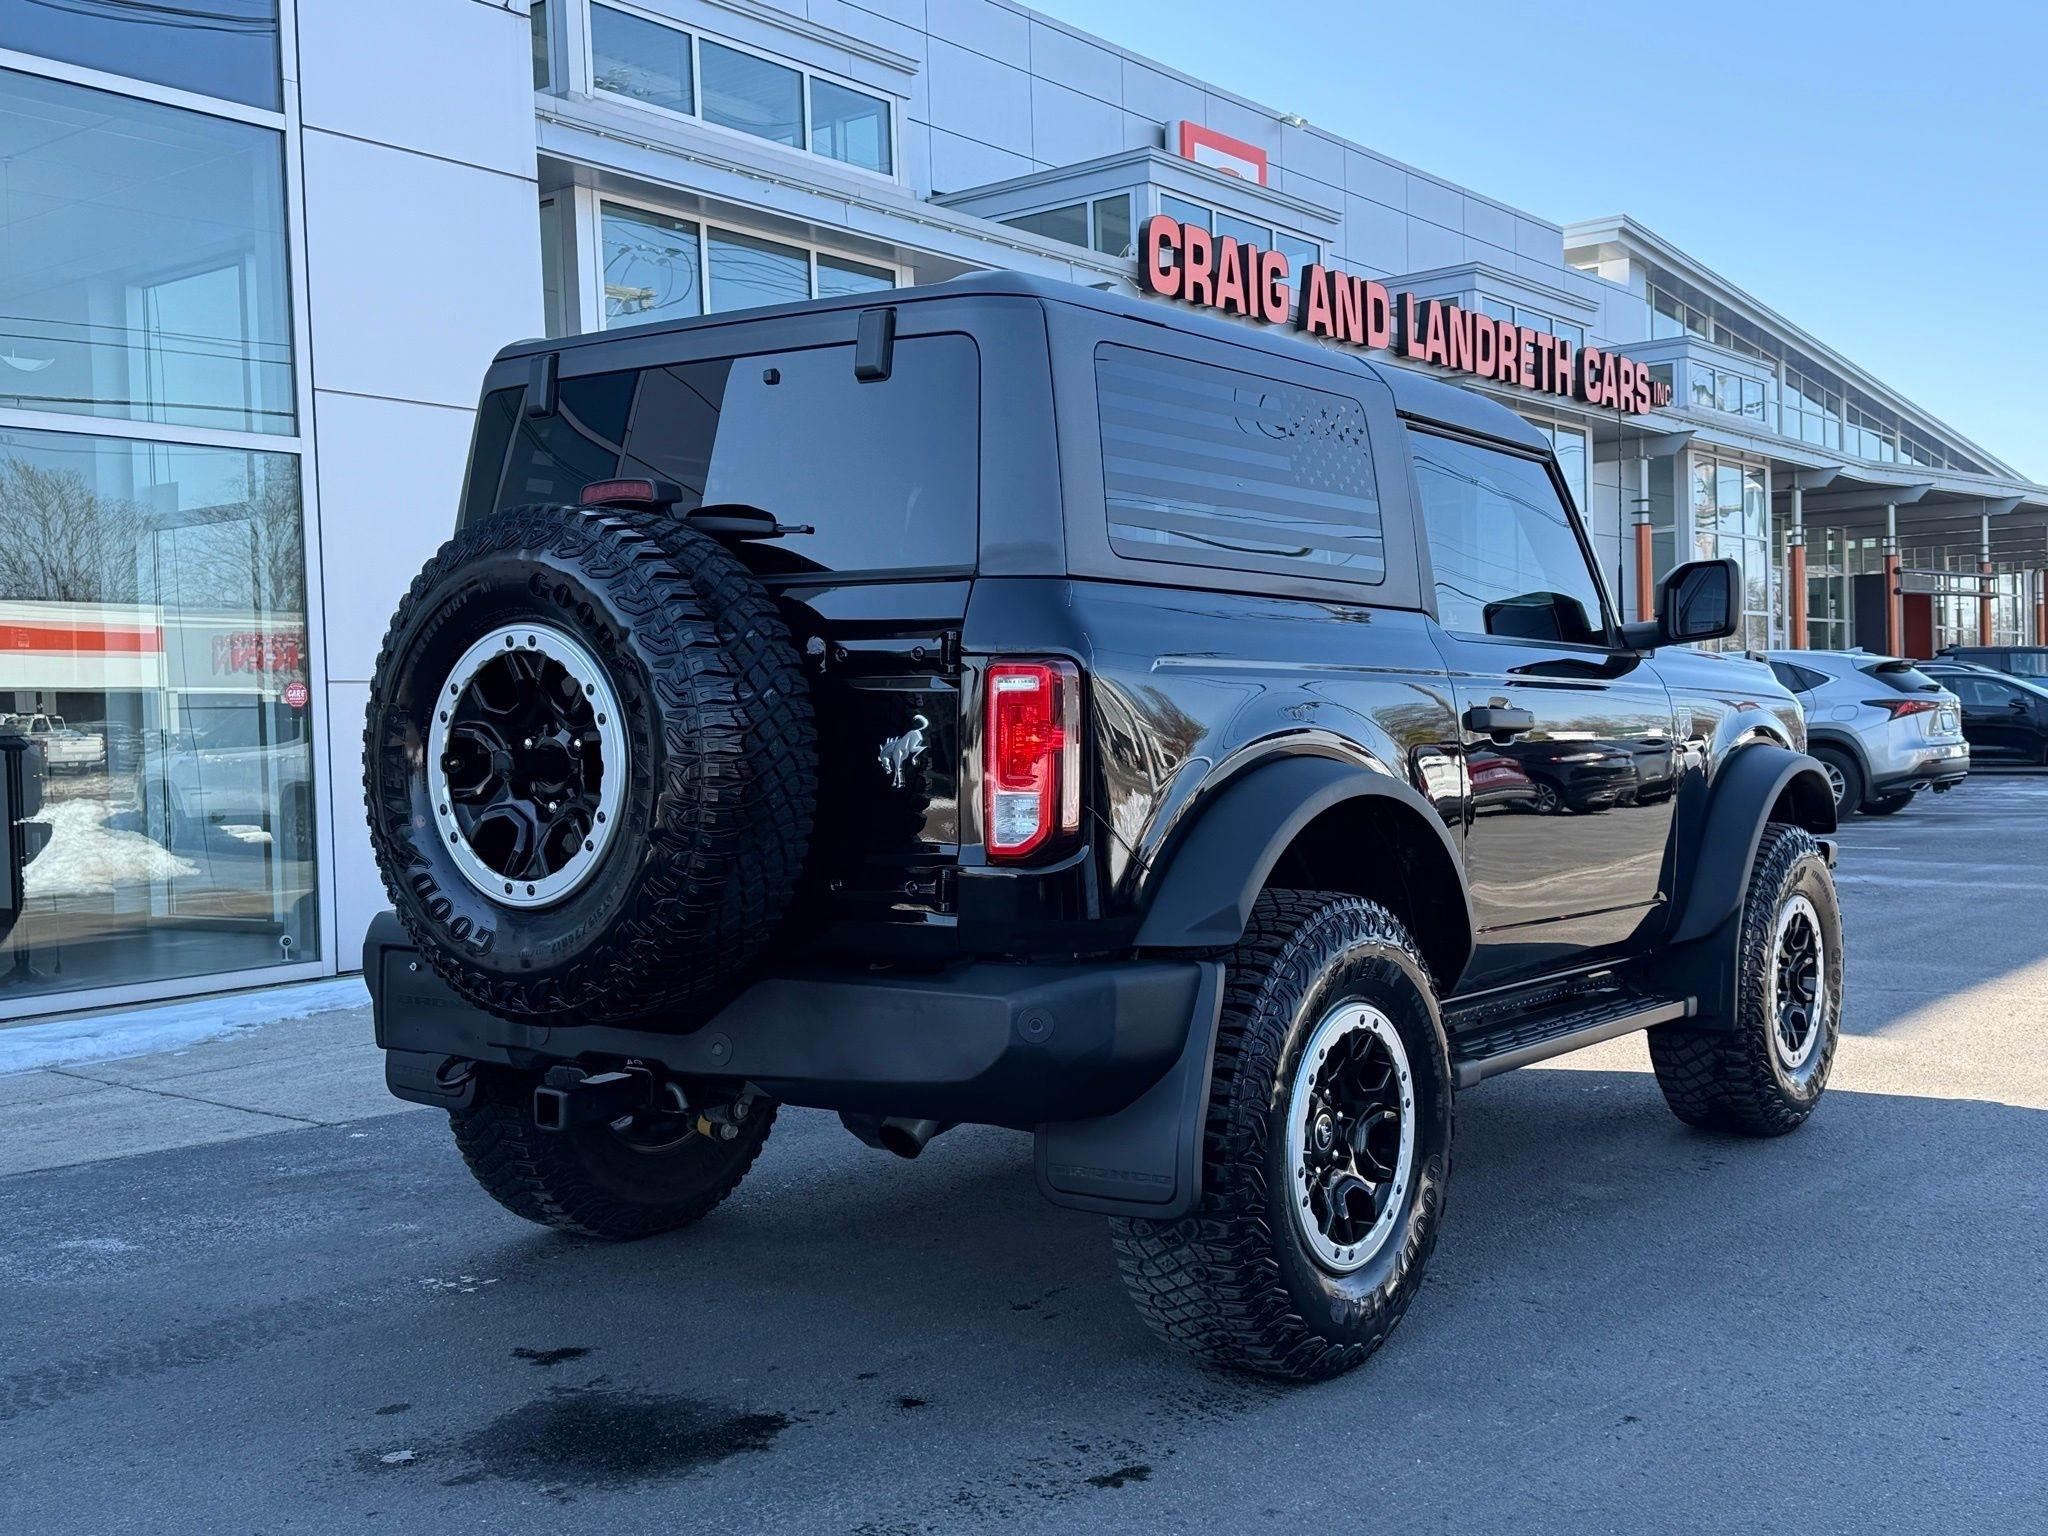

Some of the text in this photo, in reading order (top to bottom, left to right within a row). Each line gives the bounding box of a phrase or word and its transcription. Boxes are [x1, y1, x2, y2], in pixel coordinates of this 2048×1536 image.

[1142, 214, 1672, 416] CRAIG AND LANDRETH CARS INC
[287, 689, 307, 698] CARE
